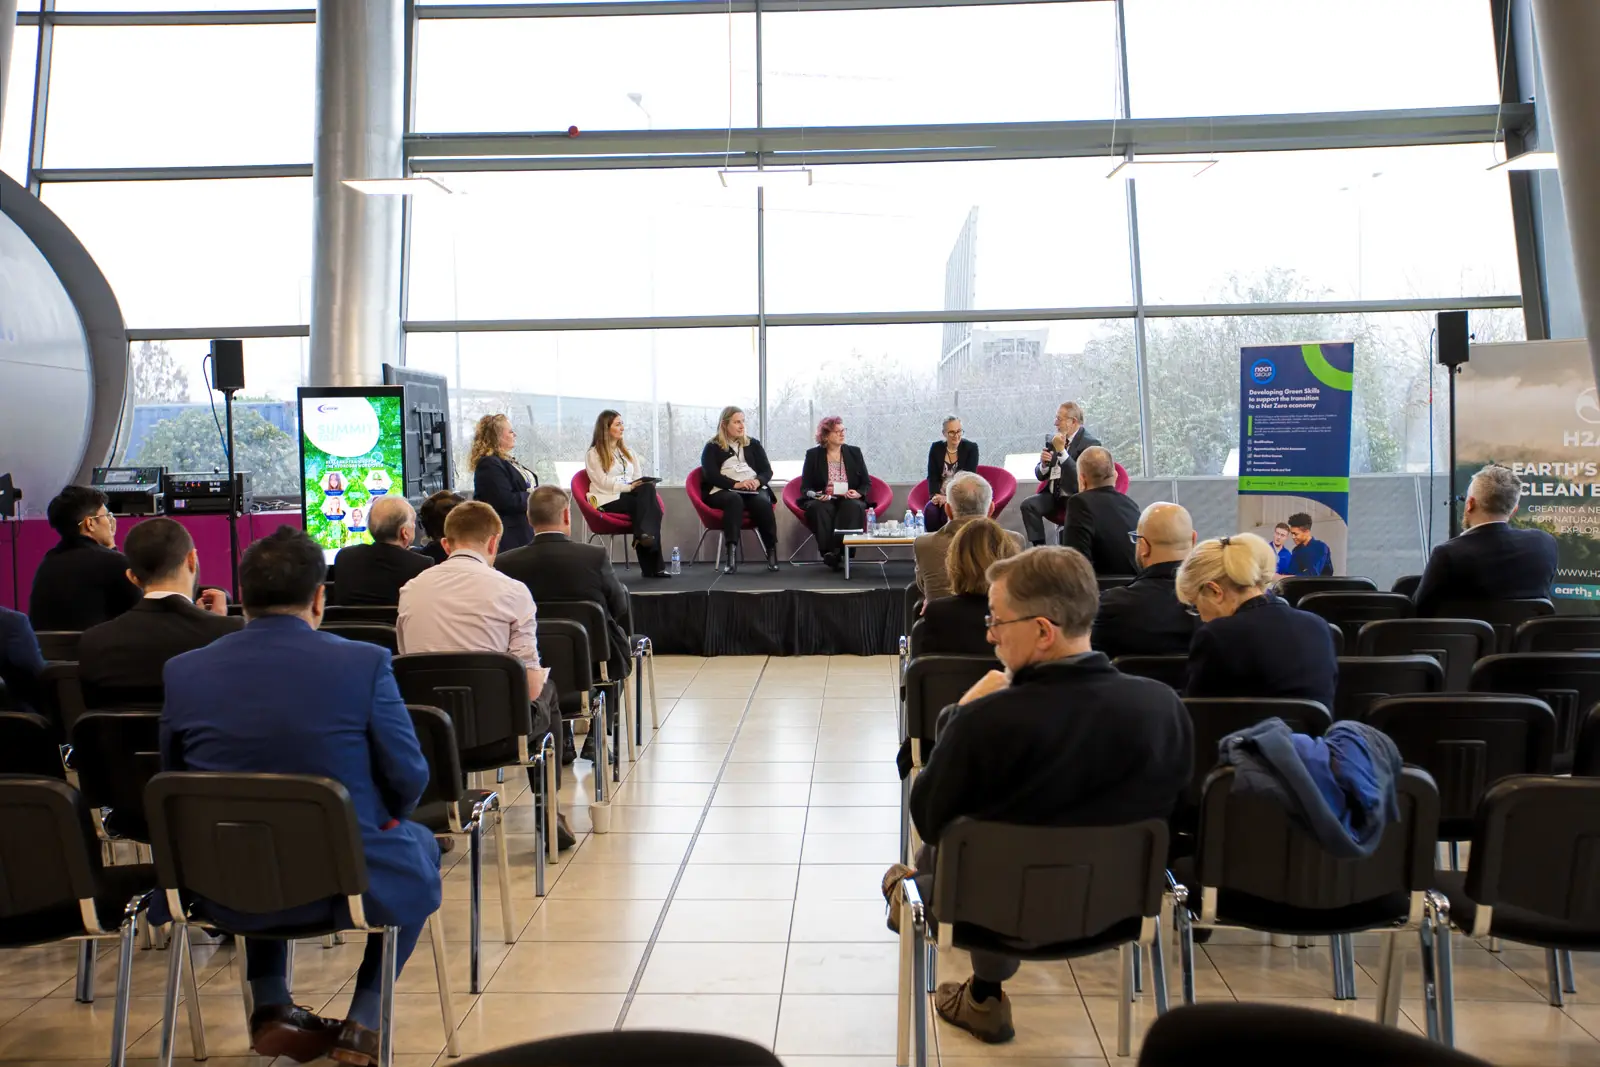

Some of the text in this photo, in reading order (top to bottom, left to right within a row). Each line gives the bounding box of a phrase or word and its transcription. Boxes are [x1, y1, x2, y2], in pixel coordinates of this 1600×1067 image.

[317, 423, 374, 435] SUMMIT
[1512, 462, 1598, 476] EARTH'S
[1520, 482, 1584, 497] CLEAN
[1528, 505, 1576, 514] CREATING
[1578, 506, 1585, 514] A
[1532, 515, 1599, 524] FOR NATURAL
